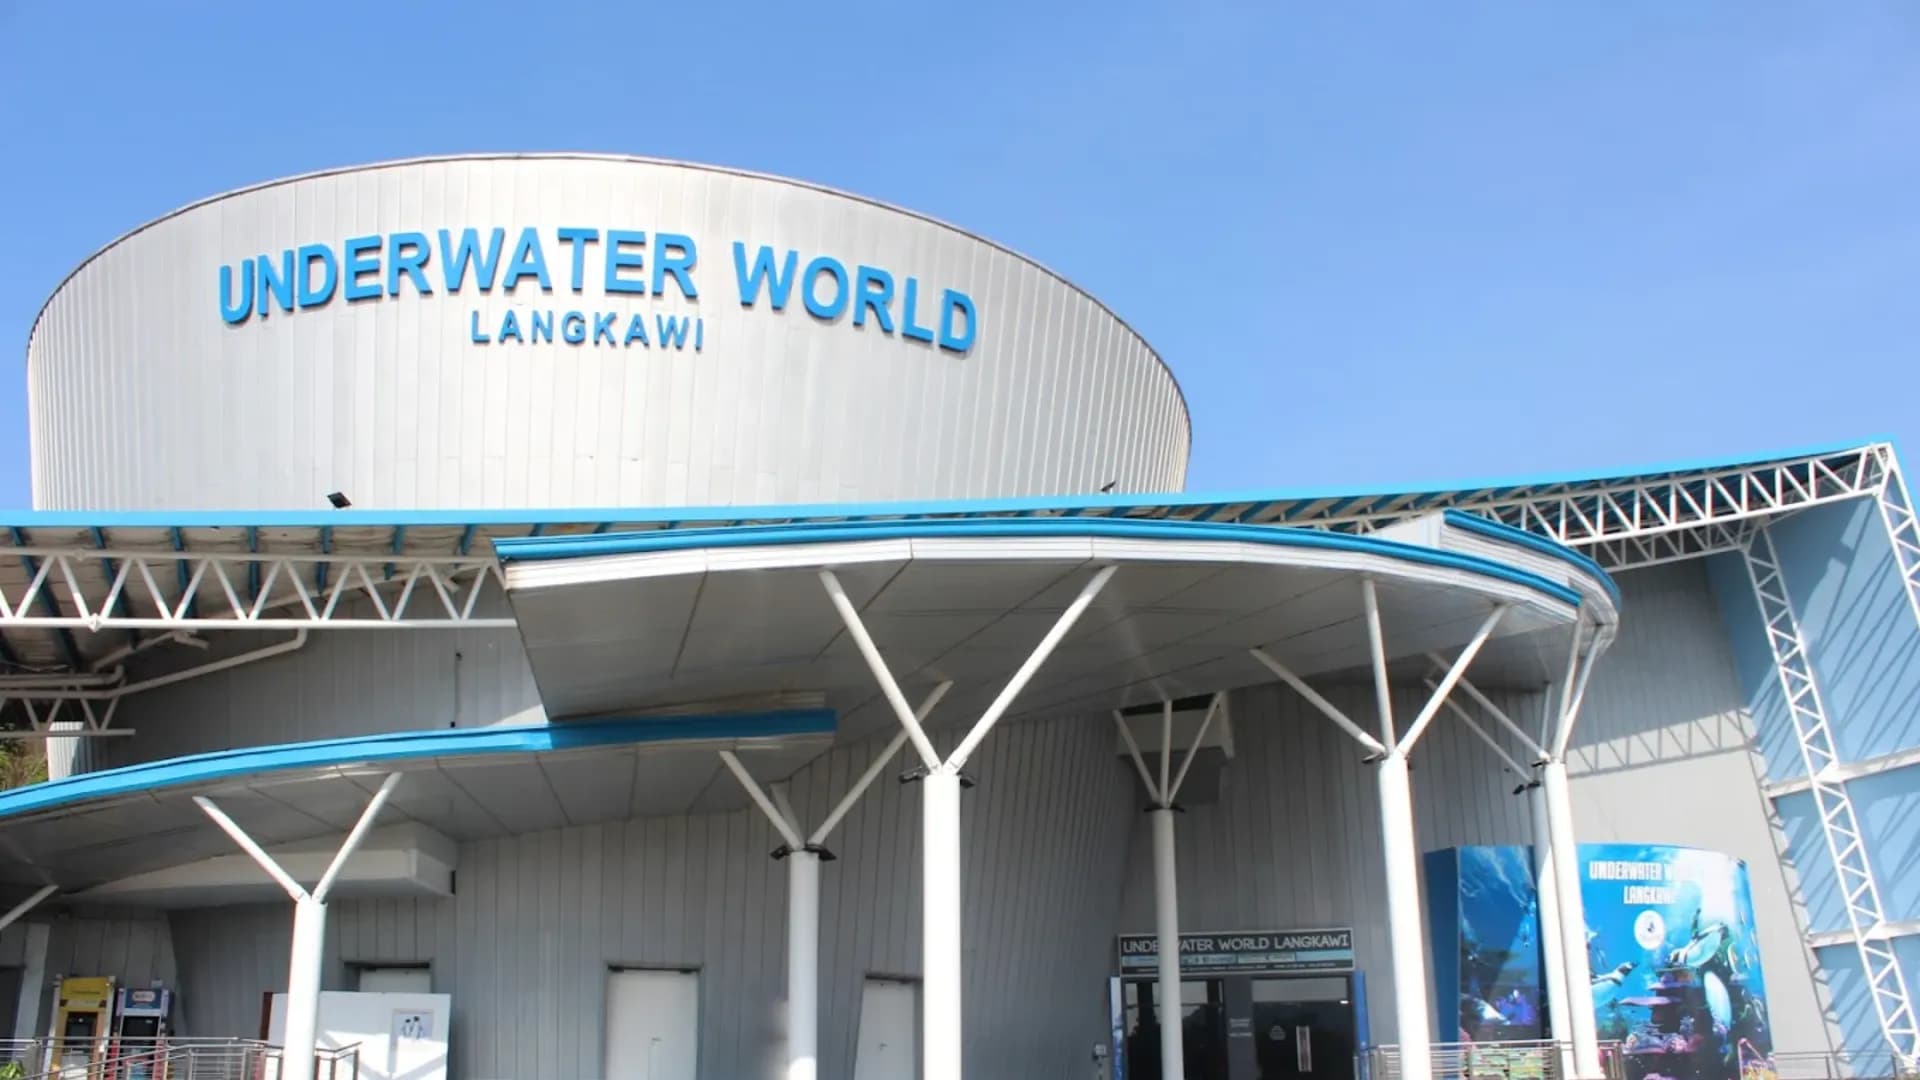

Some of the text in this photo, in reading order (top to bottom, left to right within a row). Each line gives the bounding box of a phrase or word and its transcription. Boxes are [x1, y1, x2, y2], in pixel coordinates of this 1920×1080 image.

[219, 227, 977, 353] UNDERWATER WORLD
[471, 309, 703, 351] LANGKAWI
[1589, 861, 1662, 880] UNDERWATER
[1123, 934, 1349, 953] UNDEATER WORLD LANGKAWI
